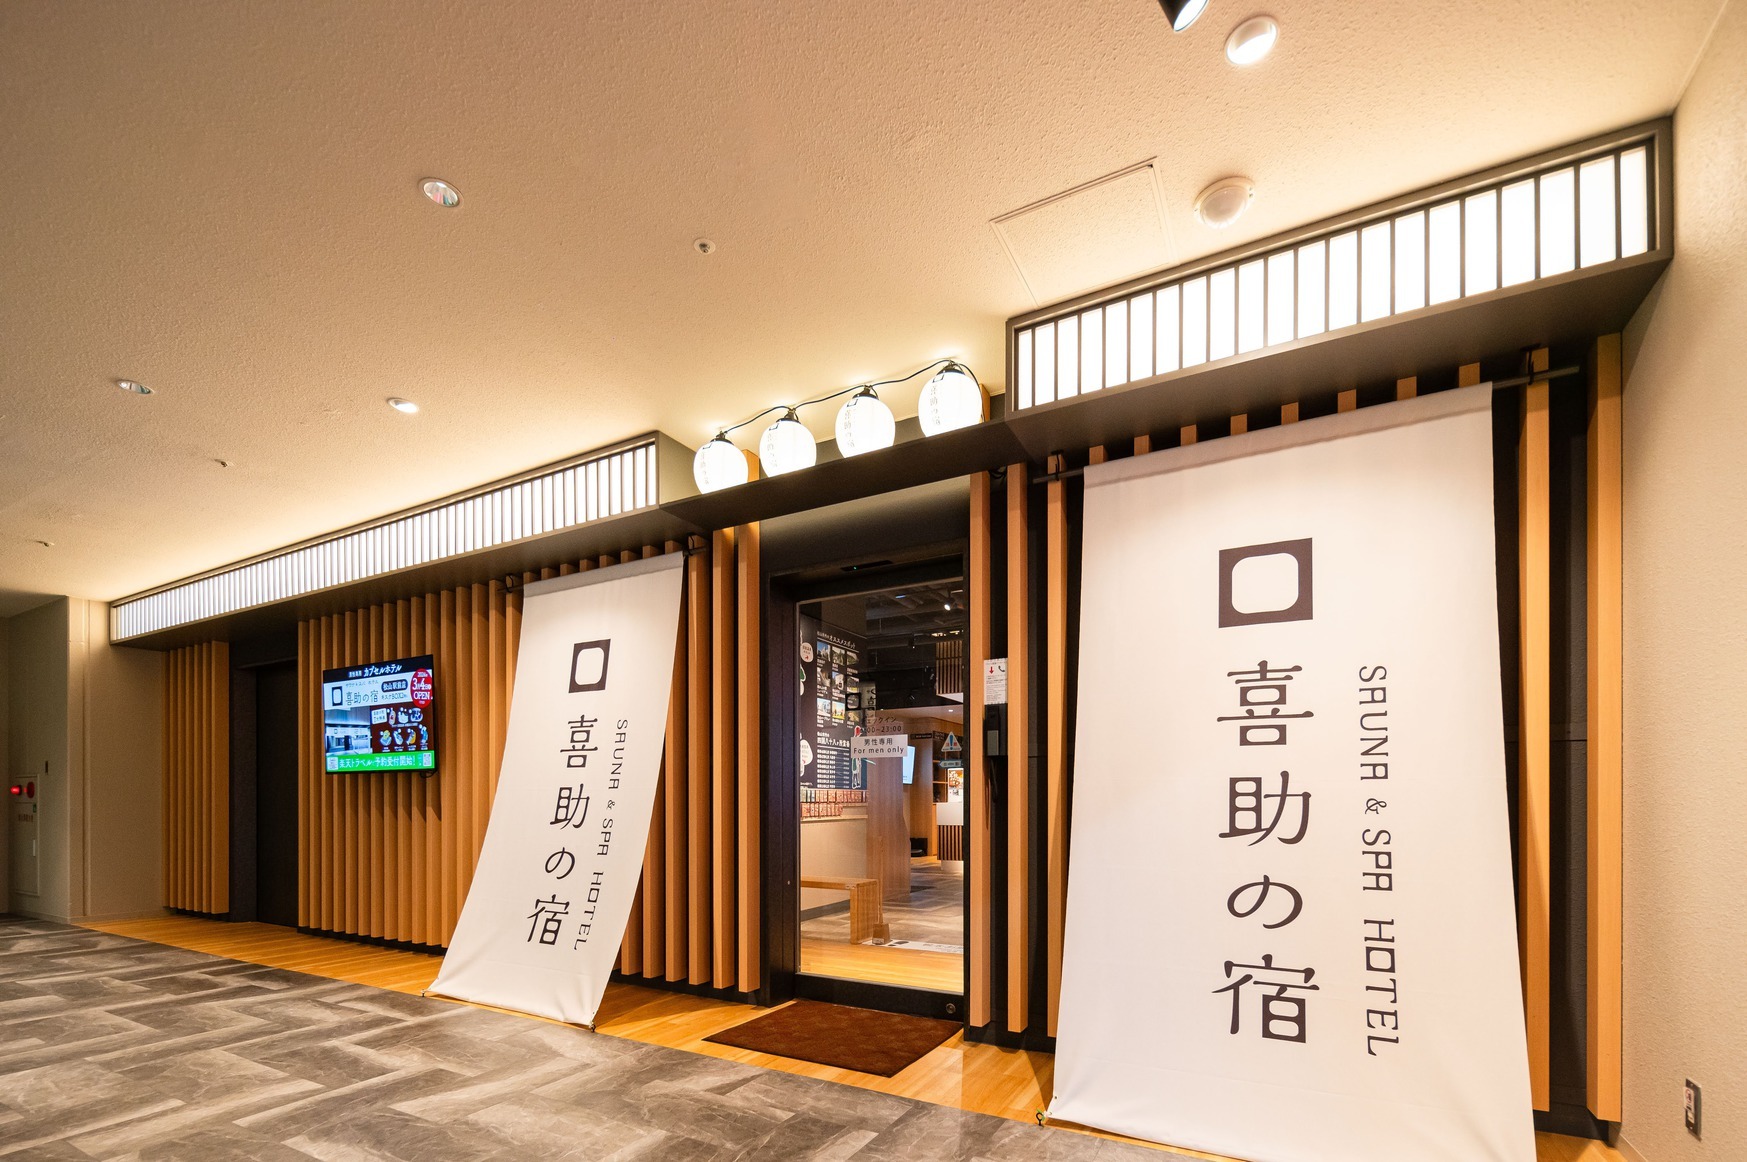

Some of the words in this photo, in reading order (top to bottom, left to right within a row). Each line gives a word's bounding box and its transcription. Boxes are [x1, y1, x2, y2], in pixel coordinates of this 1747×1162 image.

[364, 664, 402, 677] カプセルホテル
[346, 690, 379, 706] 喜助の宿
[1358, 665, 1390, 782] SAUNA
[608, 718, 628, 791] SAUNA
[864, 737, 893, 746] 男性専用
[887, 745, 905, 755] only
[526, 714, 599, 946] 喜助の宿
[606, 799, 616, 811] &
[1364, 797, 1388, 815] &
[596, 818, 614, 857] SPA
[1211, 660, 1320, 1044] 喜助の宿
[1362, 828, 1393, 892] SPA
[573, 870, 604, 951] HOTEL
[1363, 918, 1400, 1057] HOTEL
